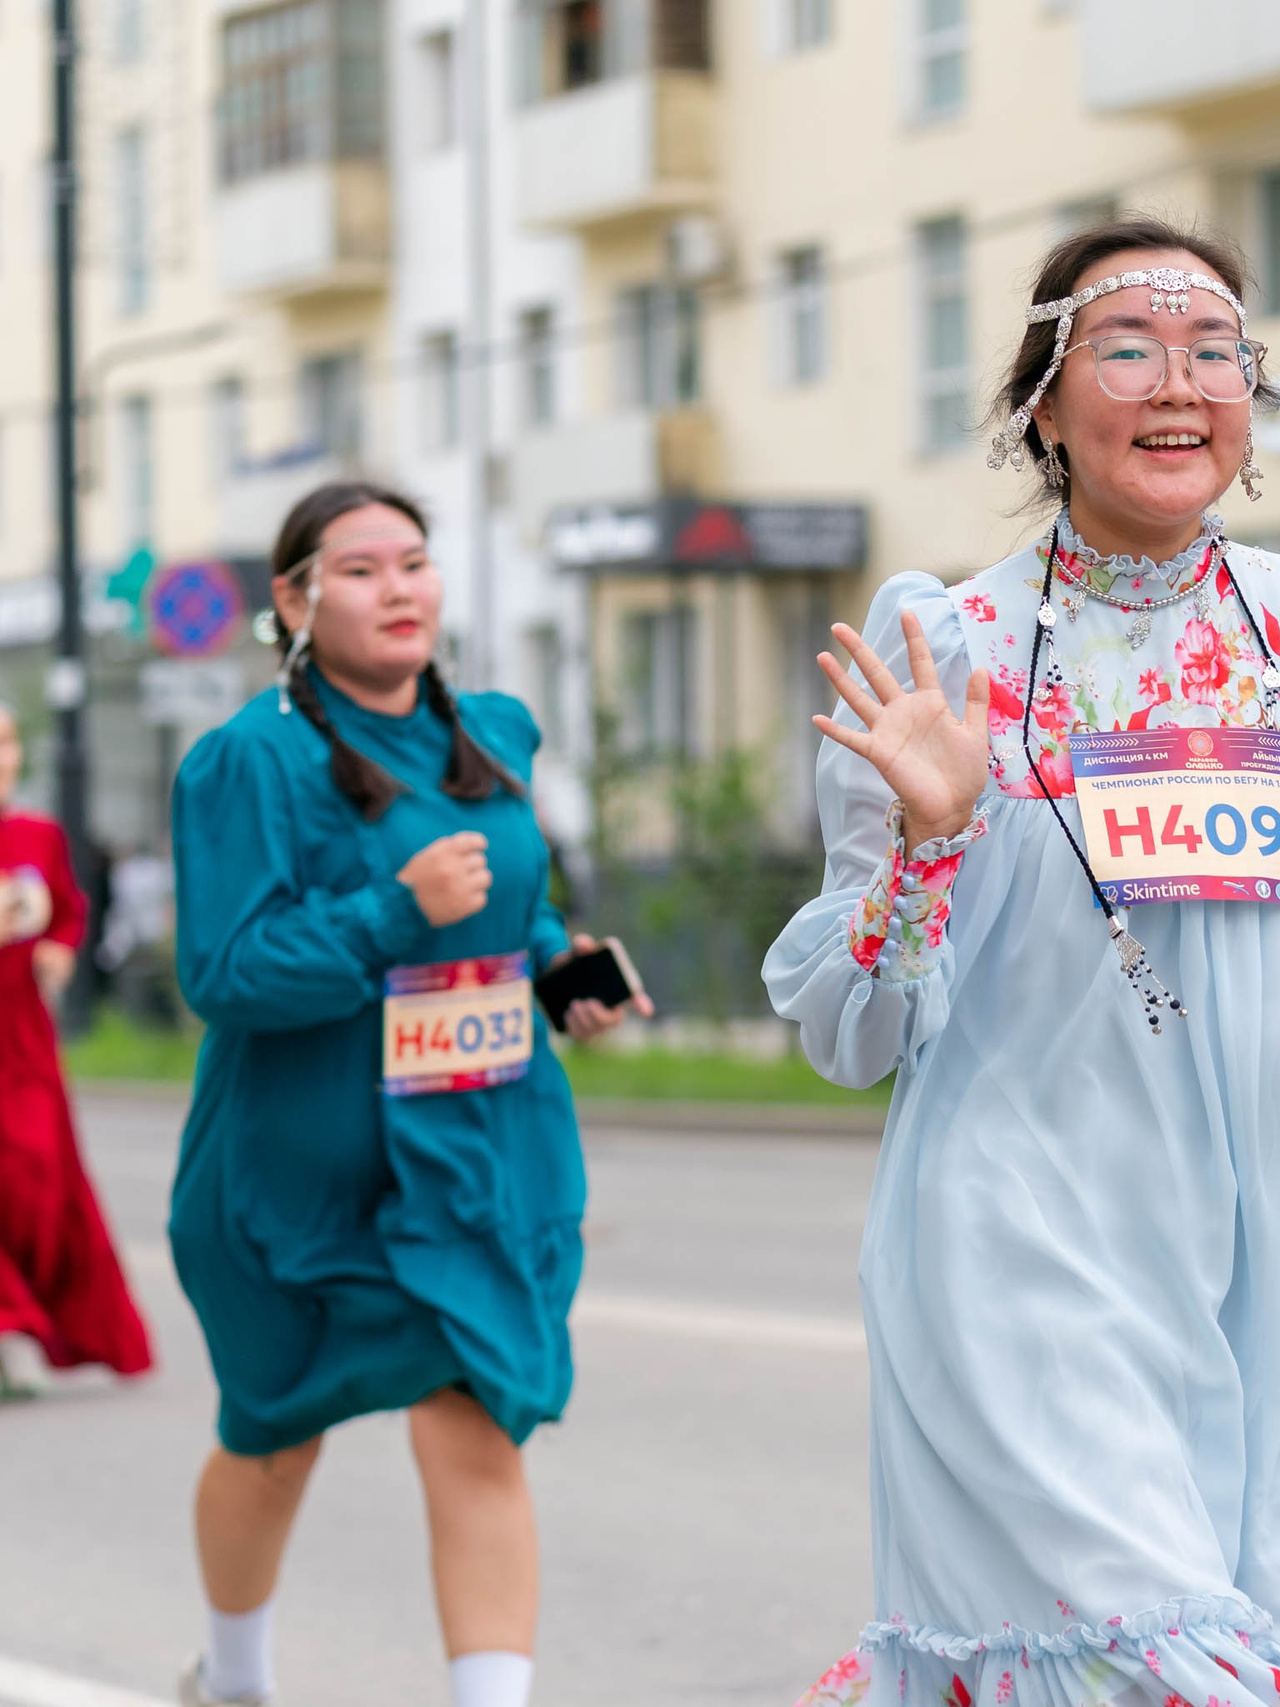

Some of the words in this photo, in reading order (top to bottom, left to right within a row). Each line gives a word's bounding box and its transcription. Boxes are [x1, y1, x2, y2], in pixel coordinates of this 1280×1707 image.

[1083, 754, 1143, 766] ДИСТАНЦИЯ
[1144, 753, 1152, 761] 4
[1154, 752, 1168, 760] КМ
[1092, 776, 1164, 790] ЧЕМПИОНАТ
[1168, 776, 1212, 785] РОССИИ
[1216, 776, 1231, 785] ПО
[1235, 776, 1258, 786] БЕГУ
[1261, 777, 1274, 788] НА
[1122, 880, 1200, 901] Skintime
